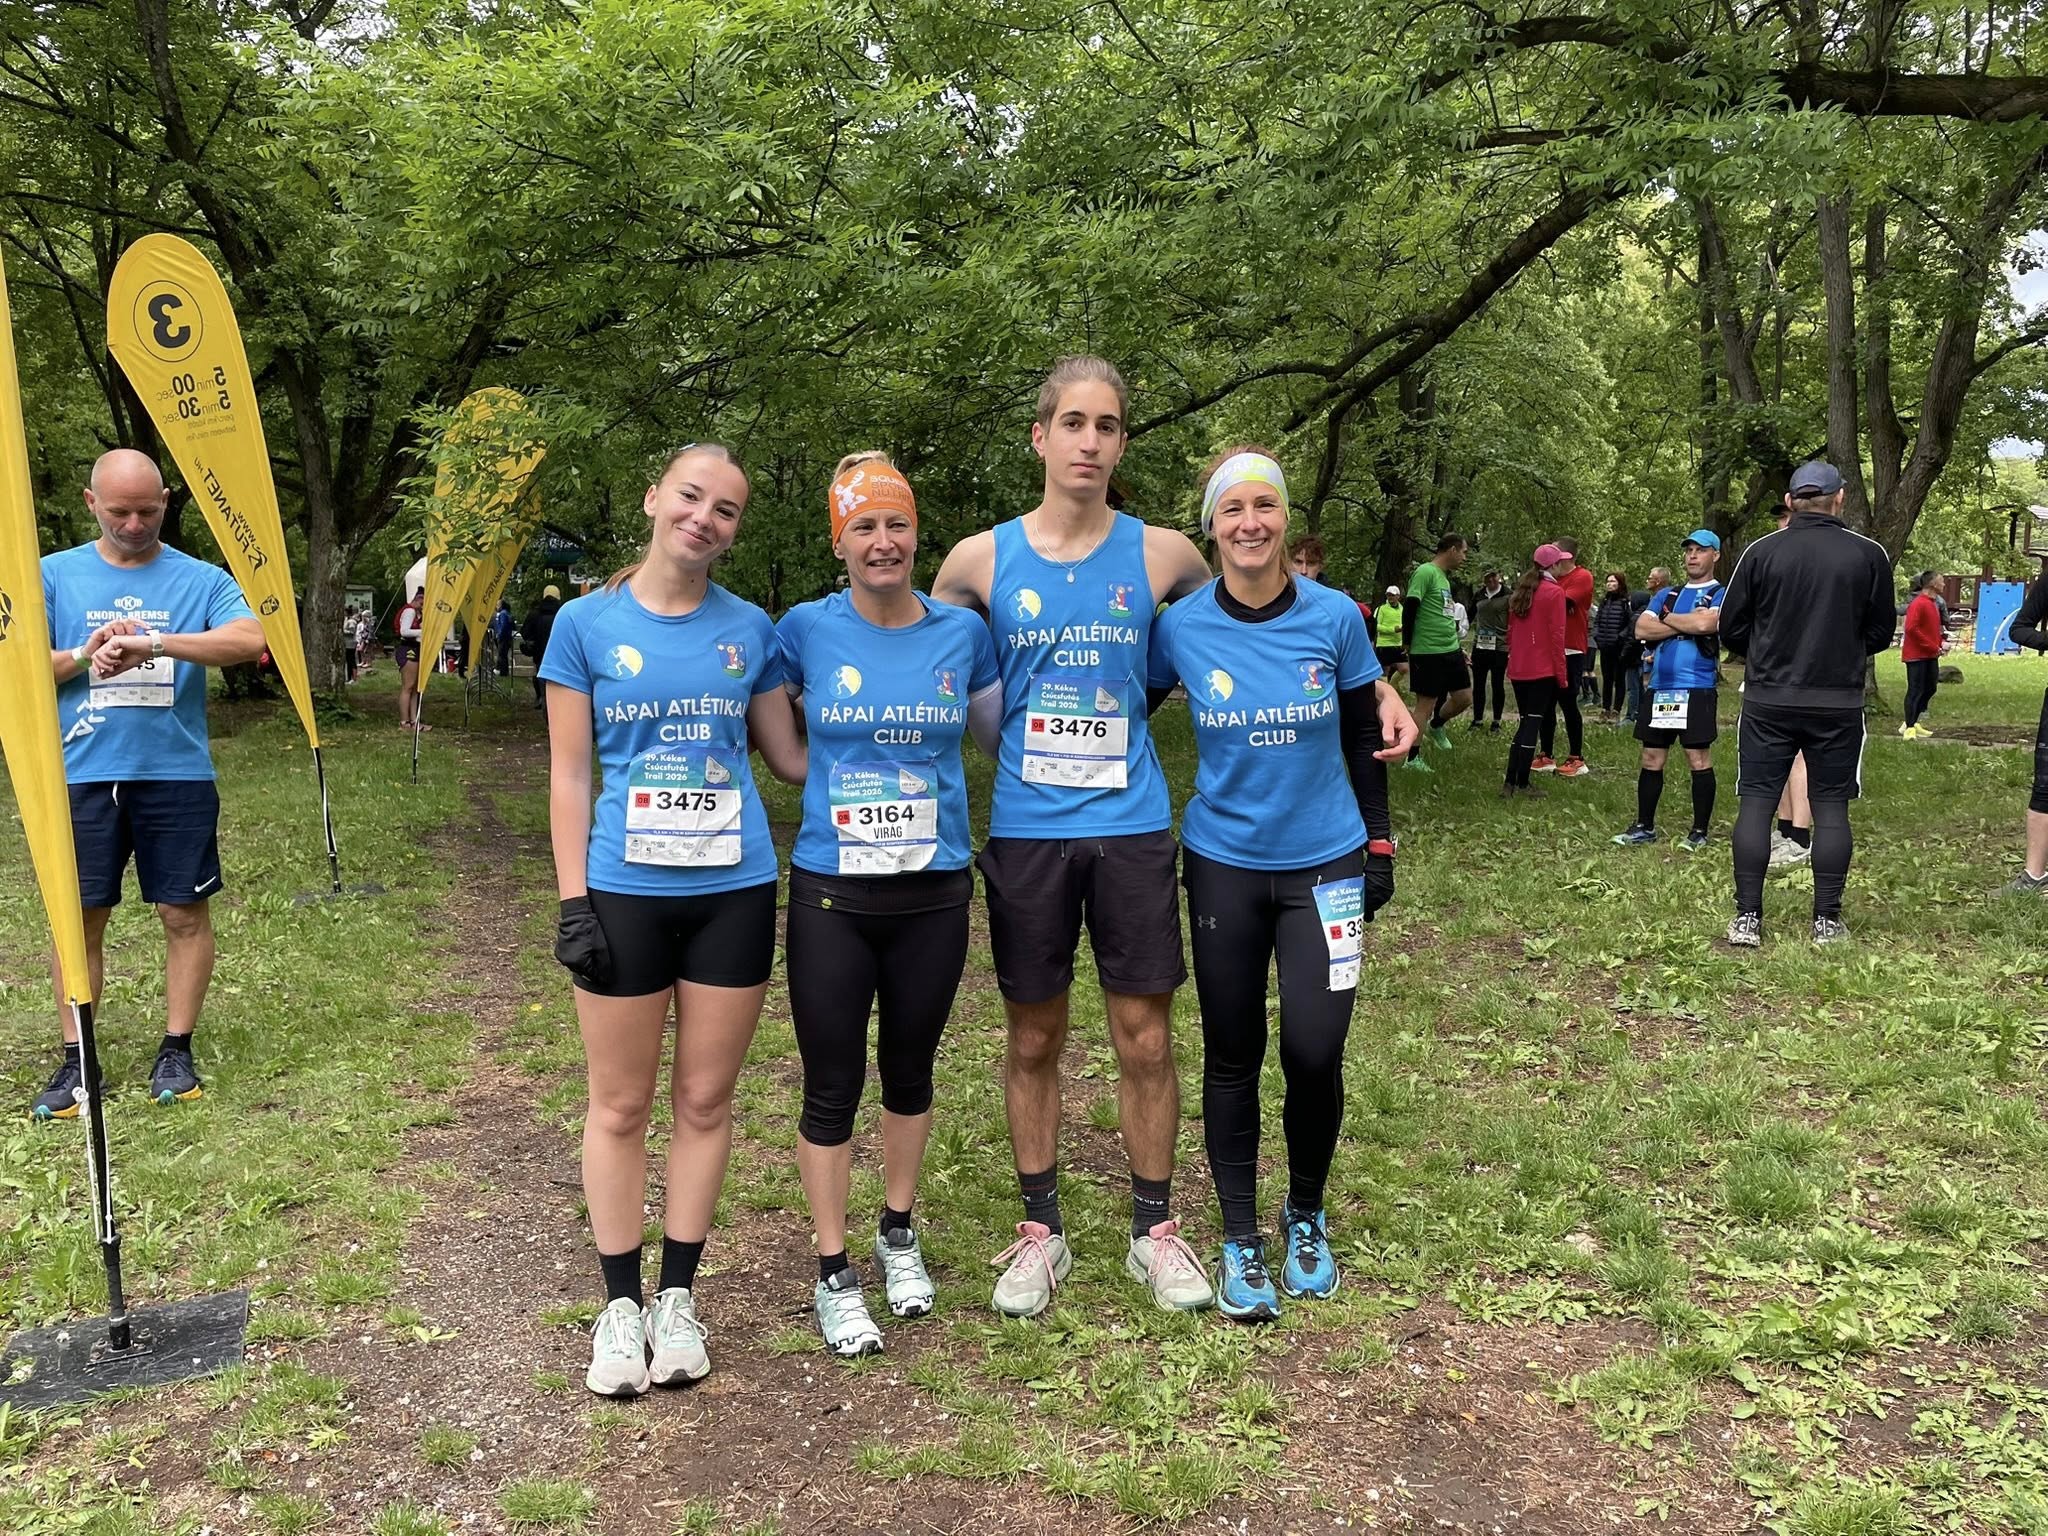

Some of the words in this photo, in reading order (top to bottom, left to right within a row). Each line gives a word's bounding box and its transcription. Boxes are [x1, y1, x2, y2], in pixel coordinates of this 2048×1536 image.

[86, 610, 170, 620] KNORR-BREMSE
[1008, 627, 1056, 649] PÁPAI
[1060, 621, 1139, 645] ATLÉTIKAI
[1054, 650, 1100, 667] CLUB
[1042, 683, 1053, 691] 29.
[1055, 683, 1078, 692] Kékes
[1041, 692, 1080, 701] Csúcsfutás
[604, 700, 660, 723] PÁPAI
[666, 693, 746, 718] ATLÉTIKAI
[821, 702, 874, 723] PÁPAI
[881, 701, 963, 724] ATLÉTIKAI
[1040, 700, 1057, 708] Trail
[1058, 701, 1079, 710] 2026
[1199, 708, 1247, 728] PÁPAI
[1254, 697, 1334, 725] ATLÉTIKAI
[659, 723, 711, 742] CLUB
[1050, 718, 1107, 738] 3476
[874, 729, 922, 744] CLUB
[1248, 729, 1297, 747] CLUB
[645, 754, 659, 762] 29.
[660, 753, 686, 763] Kékes
[644, 763, 689, 772] Csúcsfutás
[644, 772, 663, 780] Trail
[665, 772, 688, 781] 2026
[855, 771, 880, 780] Kékes
[842, 780, 883, 790] Csúcsfutás
[843, 790, 860, 798] Trail
[861, 788, 883, 797] 2026
[656, 791, 717, 811] 3475
[858, 804, 915, 825] 3164
[873, 824, 903, 839] VIRÁG
